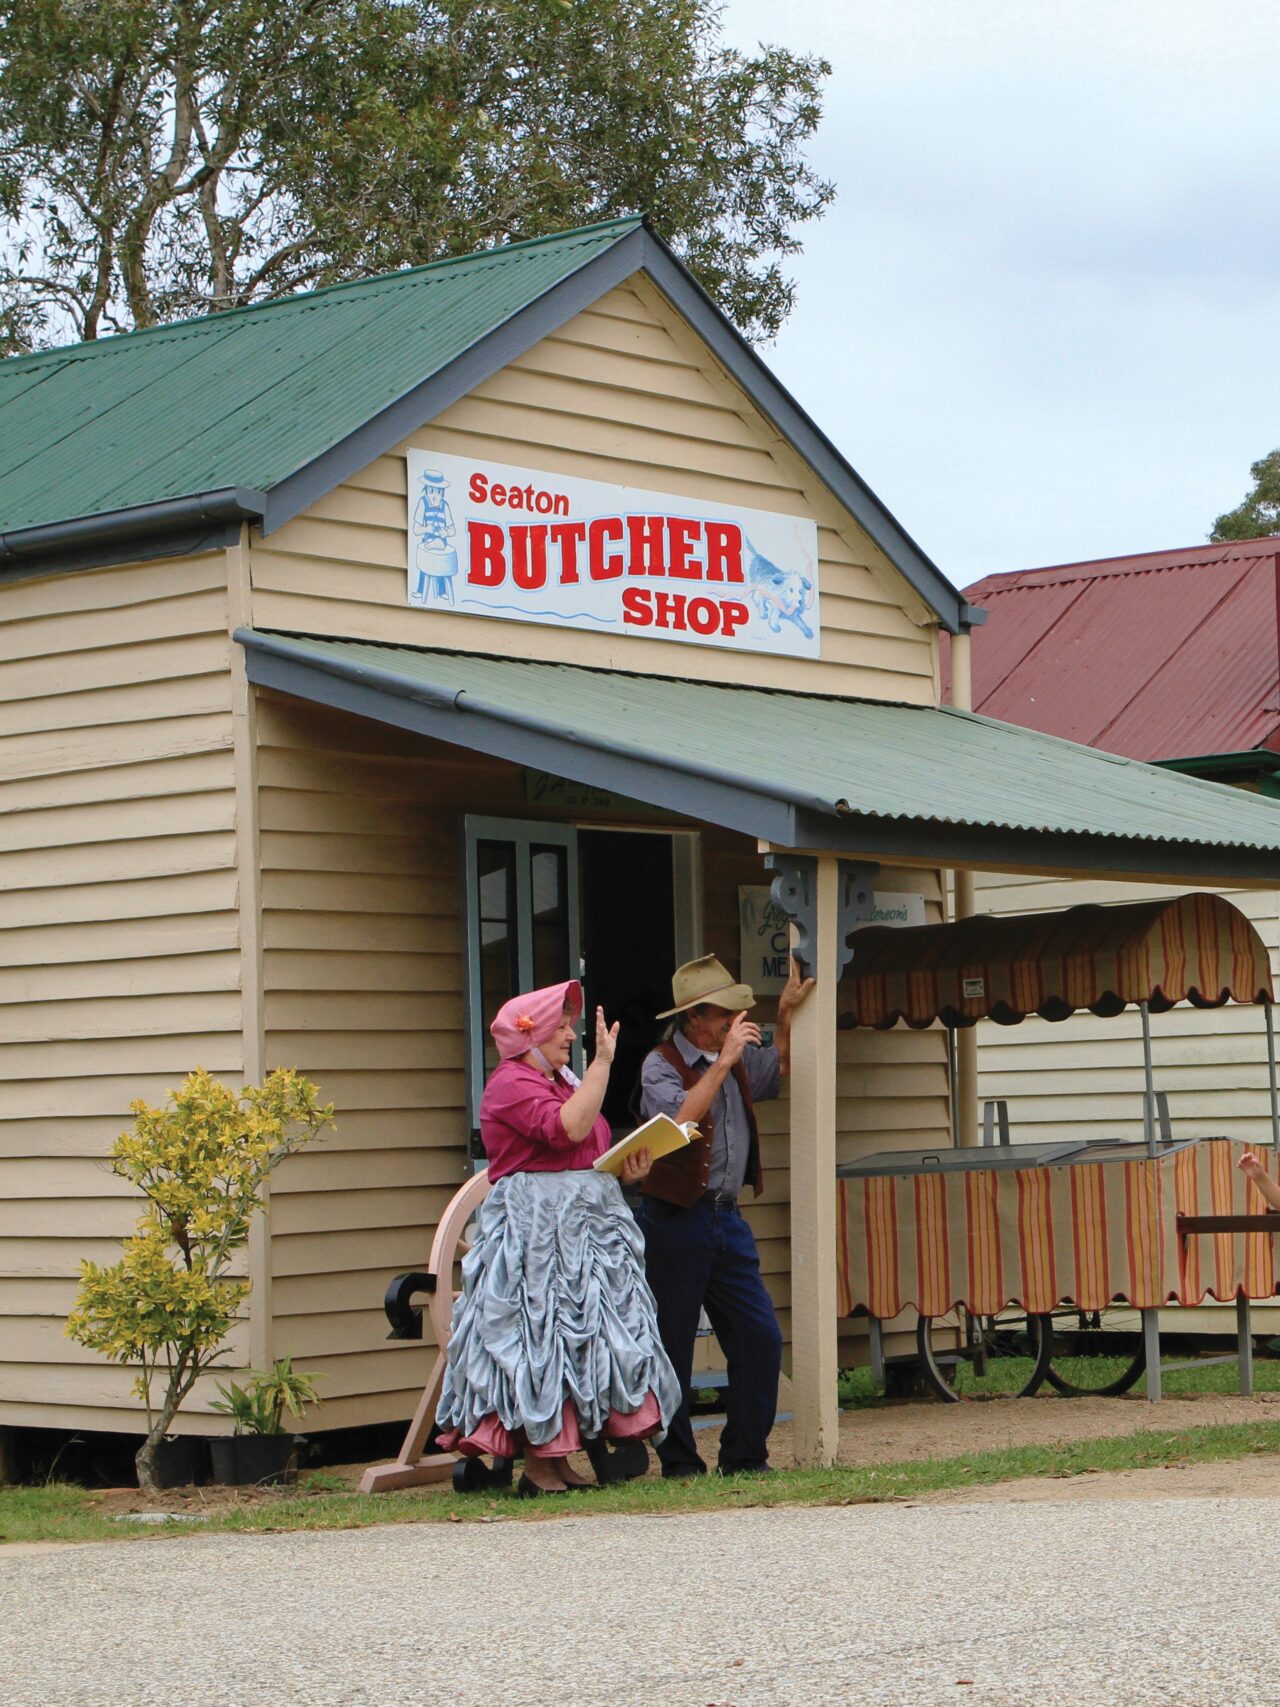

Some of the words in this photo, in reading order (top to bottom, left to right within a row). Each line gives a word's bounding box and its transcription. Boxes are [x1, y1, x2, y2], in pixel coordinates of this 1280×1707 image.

[469, 473, 570, 516] Seaton
[467, 515, 745, 590] BUTCHER
[621, 587, 750, 637] SHOP
